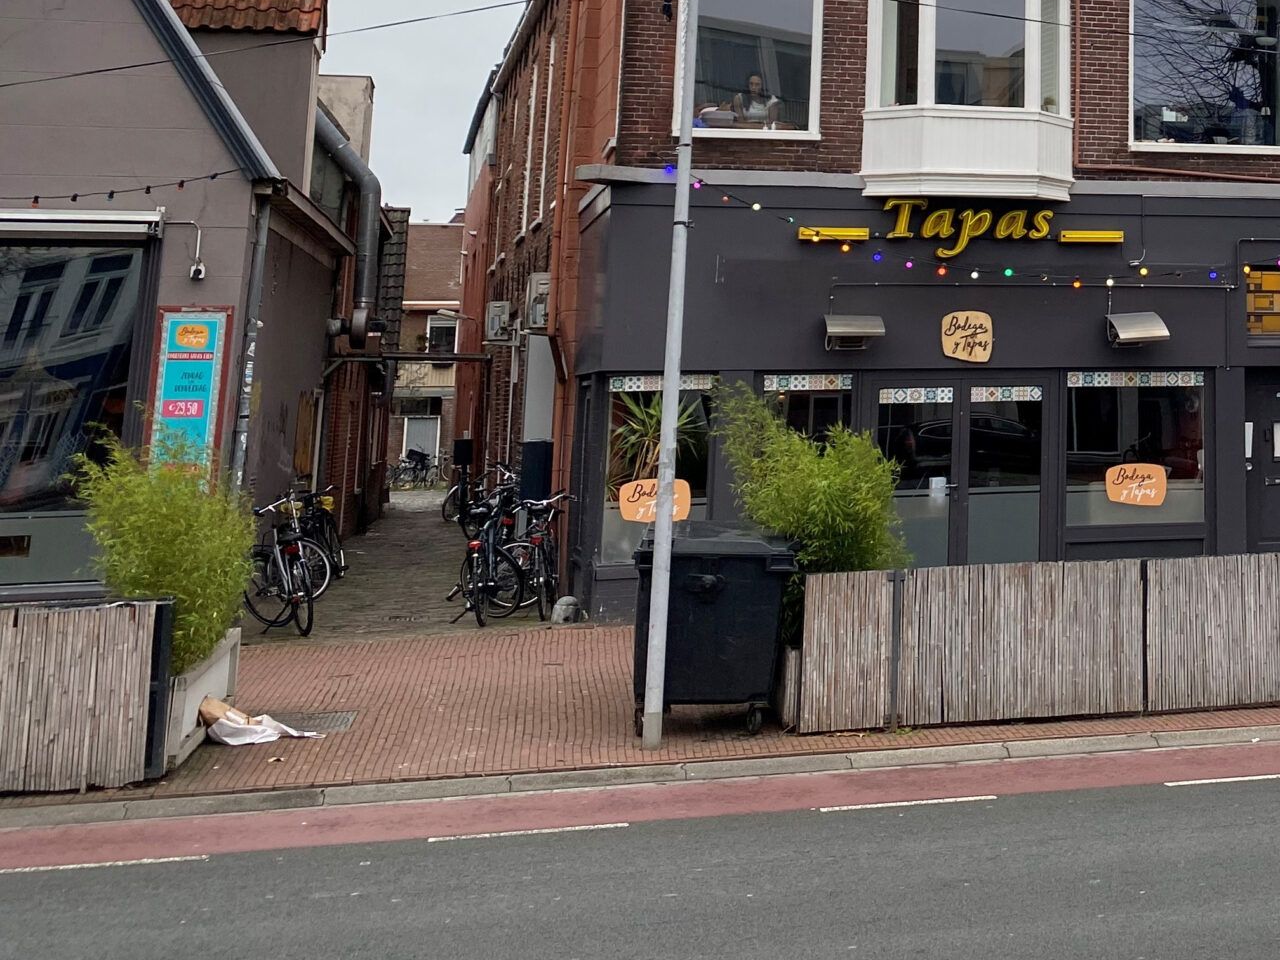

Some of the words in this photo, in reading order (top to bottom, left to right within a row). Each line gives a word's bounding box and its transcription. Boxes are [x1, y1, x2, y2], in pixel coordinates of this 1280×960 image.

[883, 198, 1054, 258] Tapas
[944, 316, 987, 338] Bodega
[952, 341, 961, 354] y
[960, 329, 990, 356] Tapas
[1112, 467, 1154, 487] Bodega
[1120, 489, 1129, 501] y
[1128, 478, 1158, 502] Tapas
